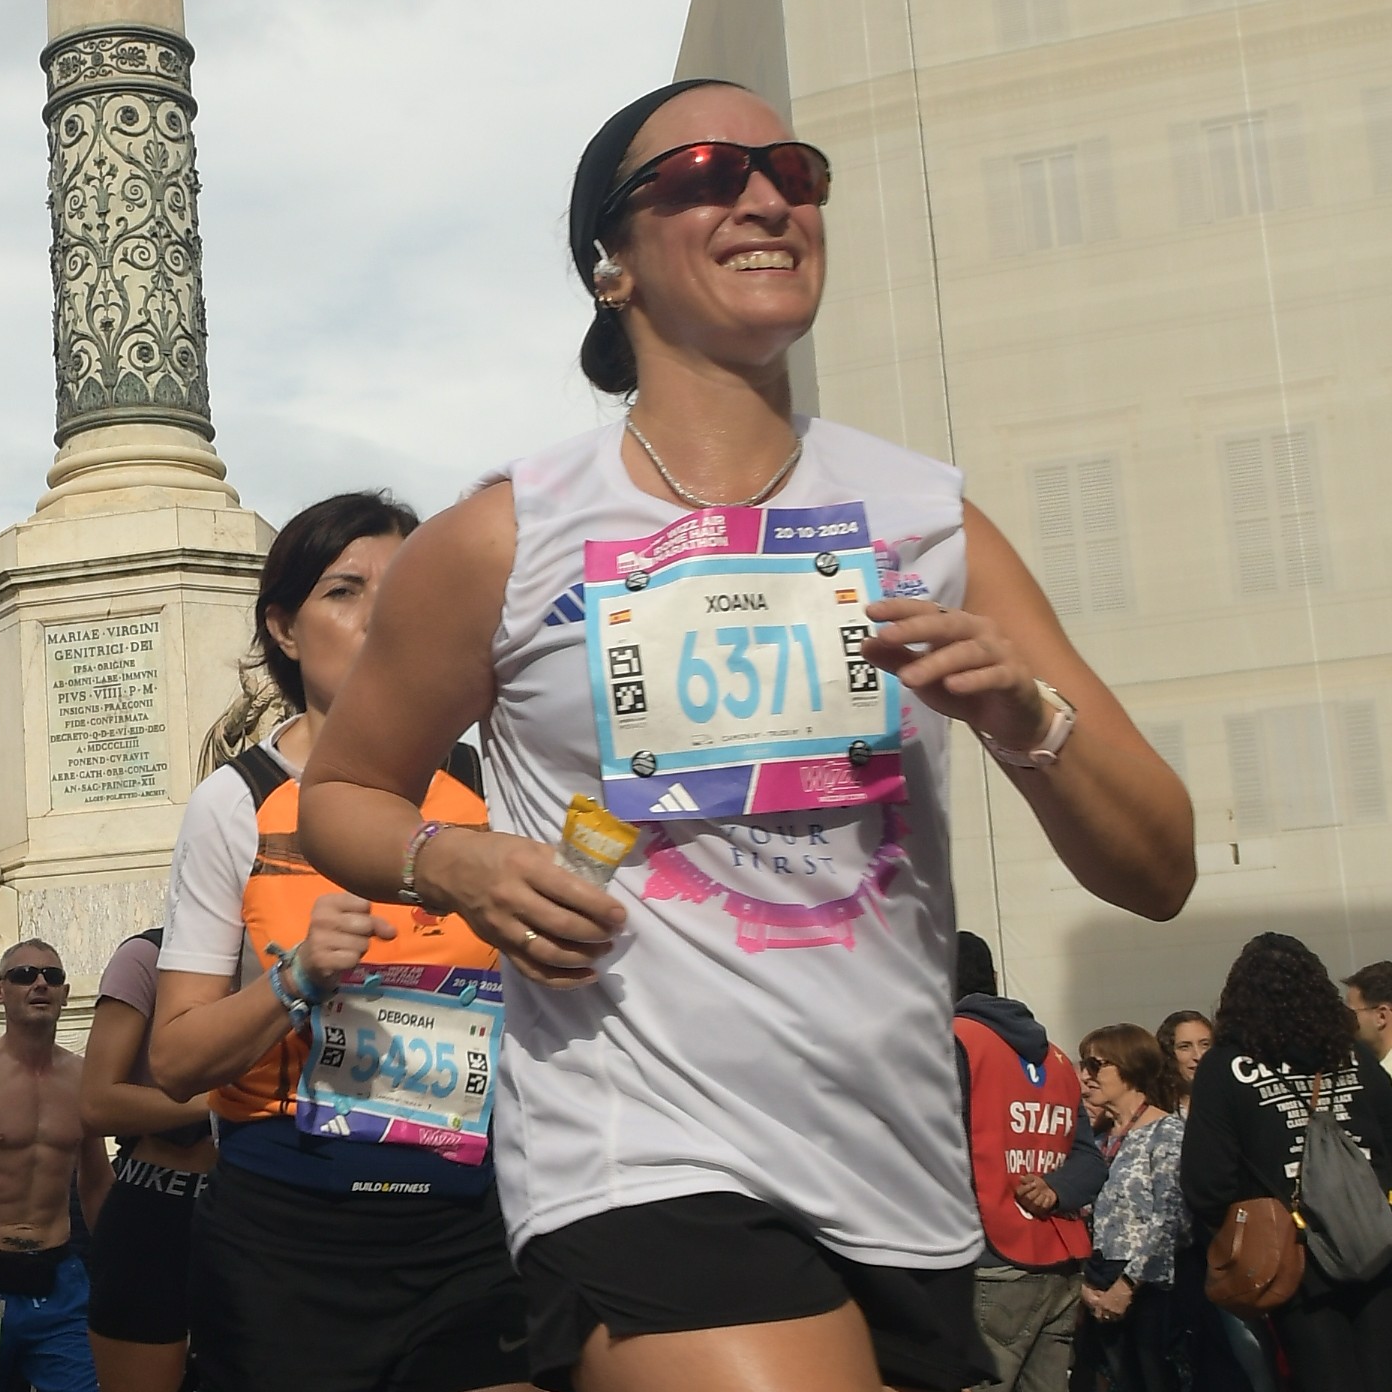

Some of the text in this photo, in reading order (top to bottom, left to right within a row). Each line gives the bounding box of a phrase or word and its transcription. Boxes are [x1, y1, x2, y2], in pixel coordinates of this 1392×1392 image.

[706, 592, 768, 614] XOANA
[47, 622, 159, 644] MARIAE VIRGINI
[54, 640, 153, 661] GENITRICI DEI
[73, 659, 136, 674] IPSA ORIGINE
[676, 623, 822, 724] 6371
[53, 669, 158, 689] AB OMNI LABE IMMVNI
[58, 691, 87, 704] PIVS
[93, 686, 123, 700] VIIII
[59, 699, 153, 717] INSIGNIS PRAECONII
[64, 713, 149, 729] FIDE CONFIRMATA
[50, 731, 89, 743] DECRETO
[68, 751, 150, 767] PONEND CVRAVIT
[51, 771, 76, 782] AERE
[79, 769, 103, 779] CATH
[127, 763, 168, 775] CONLATO
[720, 824, 830, 846] YOUR
[730, 847, 836, 875] FIRST
[377, 1009, 435, 1031] DEBORAH
[351, 1027, 458, 1099] 5425
[118, 1158, 191, 1197] NIKE
[351, 1181, 432, 1194] BUILD&FITNESS
